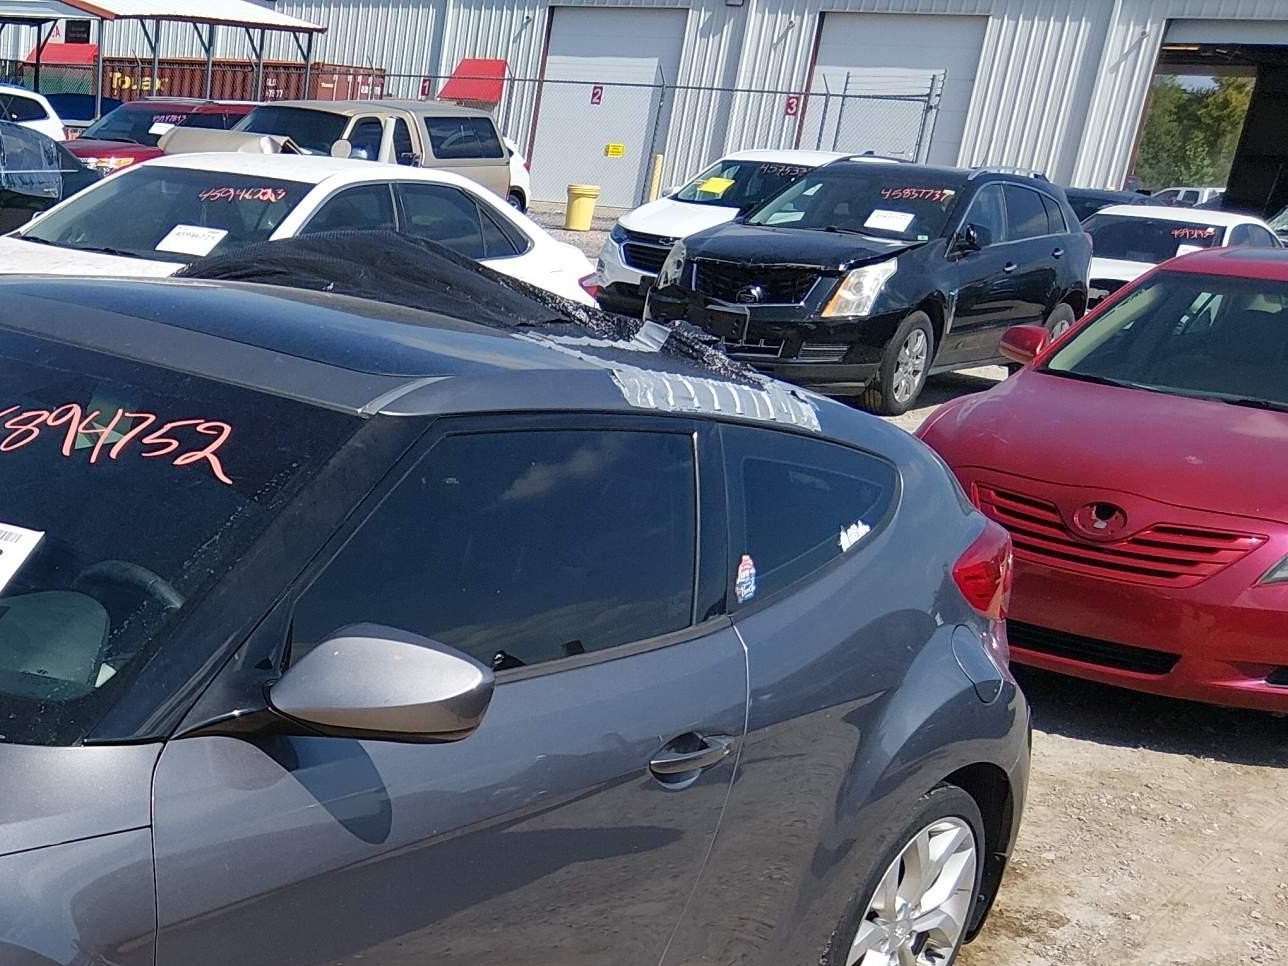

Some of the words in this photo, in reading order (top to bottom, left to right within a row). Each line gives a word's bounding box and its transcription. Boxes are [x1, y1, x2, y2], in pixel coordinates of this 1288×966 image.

[423, 80, 430, 95] 1
[592, 88, 601, 102] 2
[787, 98, 797, 114] 3
